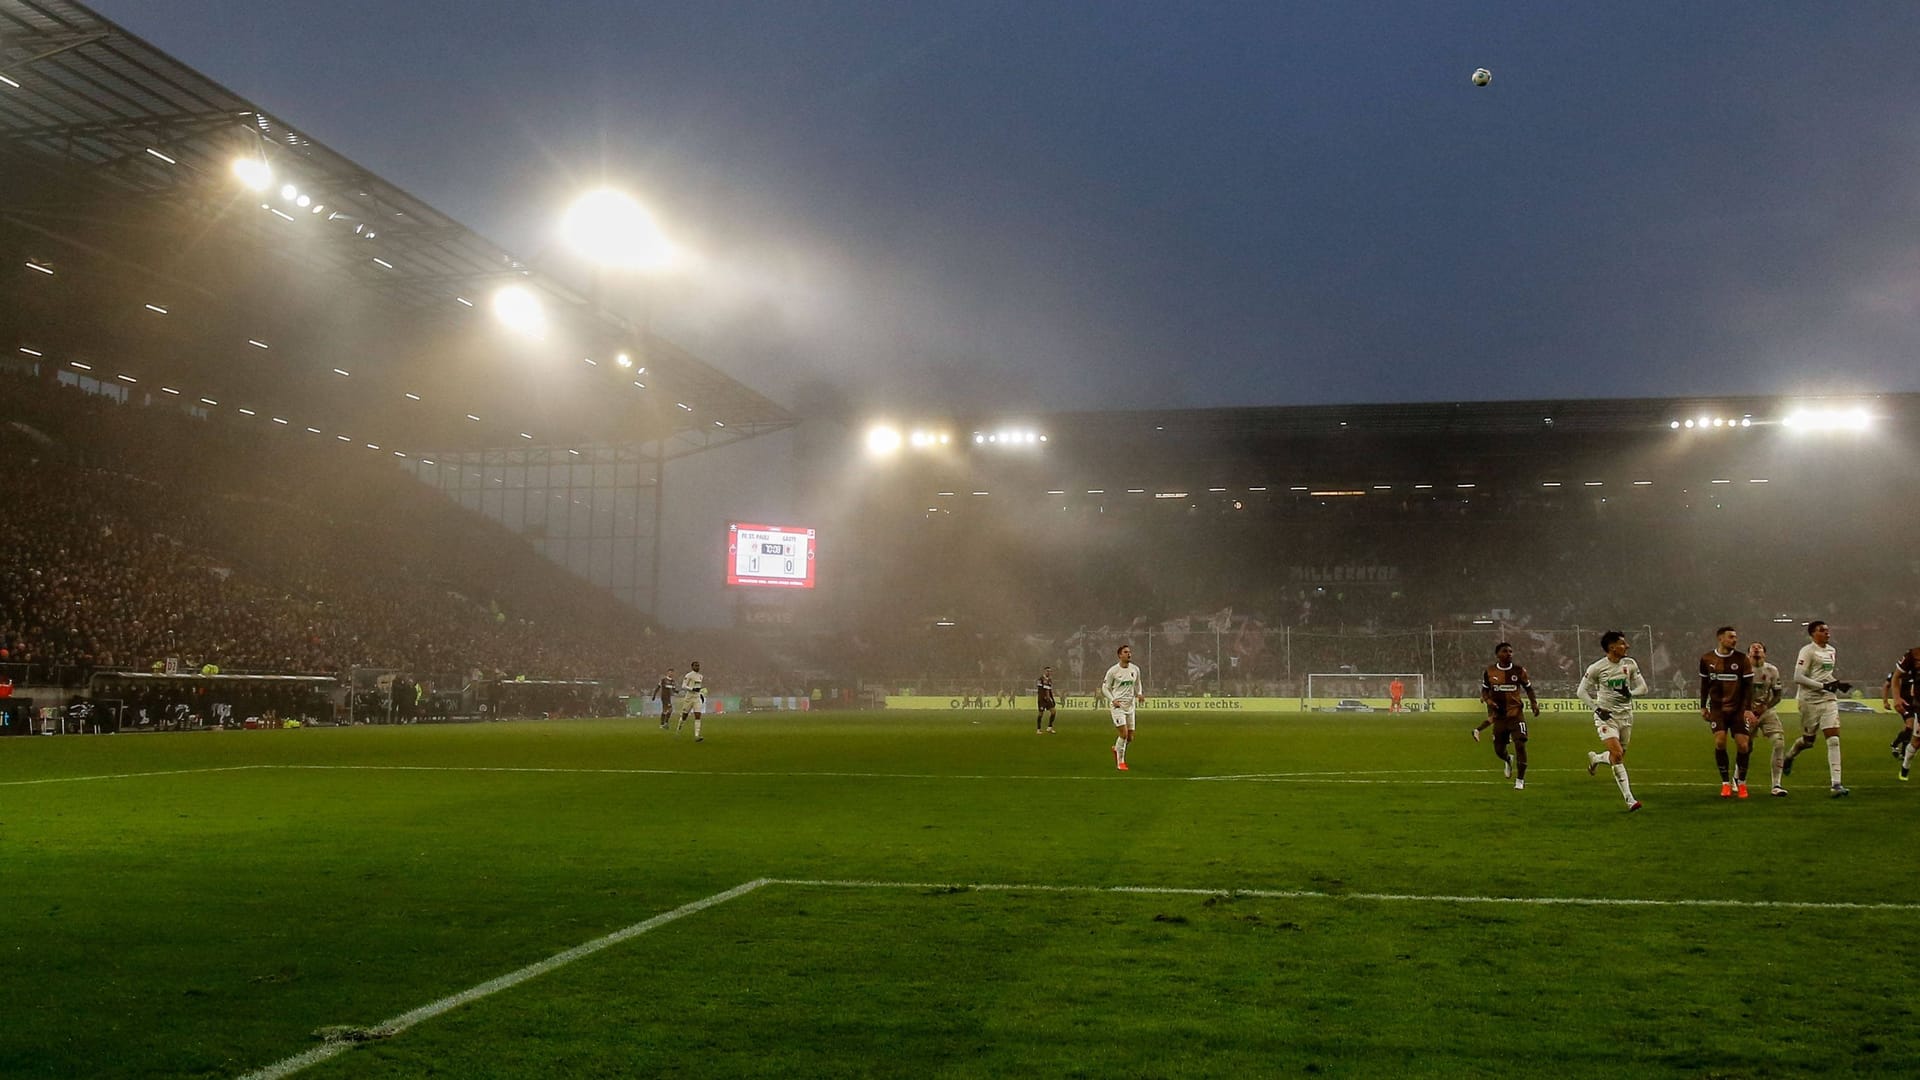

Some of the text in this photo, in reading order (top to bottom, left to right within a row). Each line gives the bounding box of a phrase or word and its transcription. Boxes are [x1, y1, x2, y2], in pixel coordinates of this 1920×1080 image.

[786, 560, 793, 572] 0
[1066, 698, 1088, 709] Hier
[1153, 699, 1180, 709] links
[1183, 701, 1201, 709] vor
[1204, 699, 1243, 709] rechts.
[1552, 700, 1575, 713] gilt
[1651, 703, 1671, 711] vor
